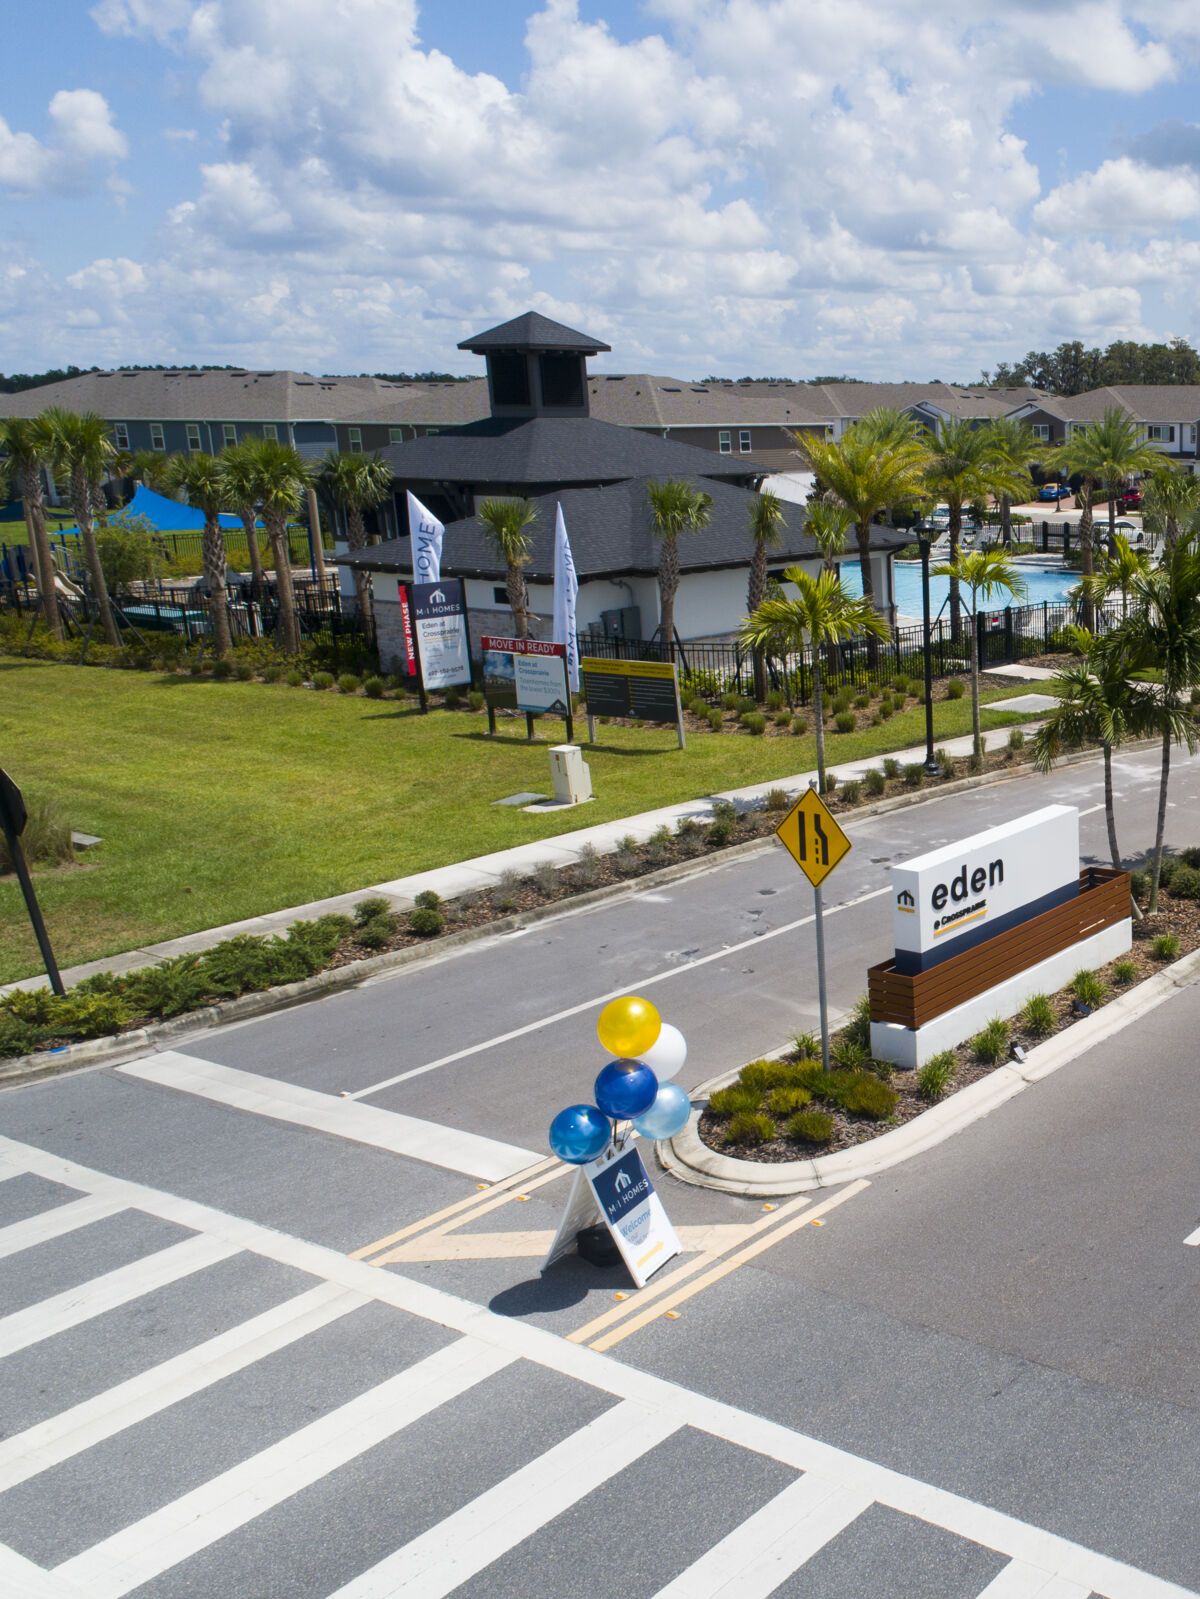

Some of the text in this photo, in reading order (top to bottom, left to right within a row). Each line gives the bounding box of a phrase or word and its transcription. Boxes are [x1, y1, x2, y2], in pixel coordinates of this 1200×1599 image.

[418, 515, 435, 584] HOME
[432, 604, 461, 614] HOMES
[403, 602, 415, 660] NEW PHASE
[489, 639, 555, 654] MOVE IN READY
[932, 859, 1004, 910] eden
[622, 1178, 649, 1204] HOMES
